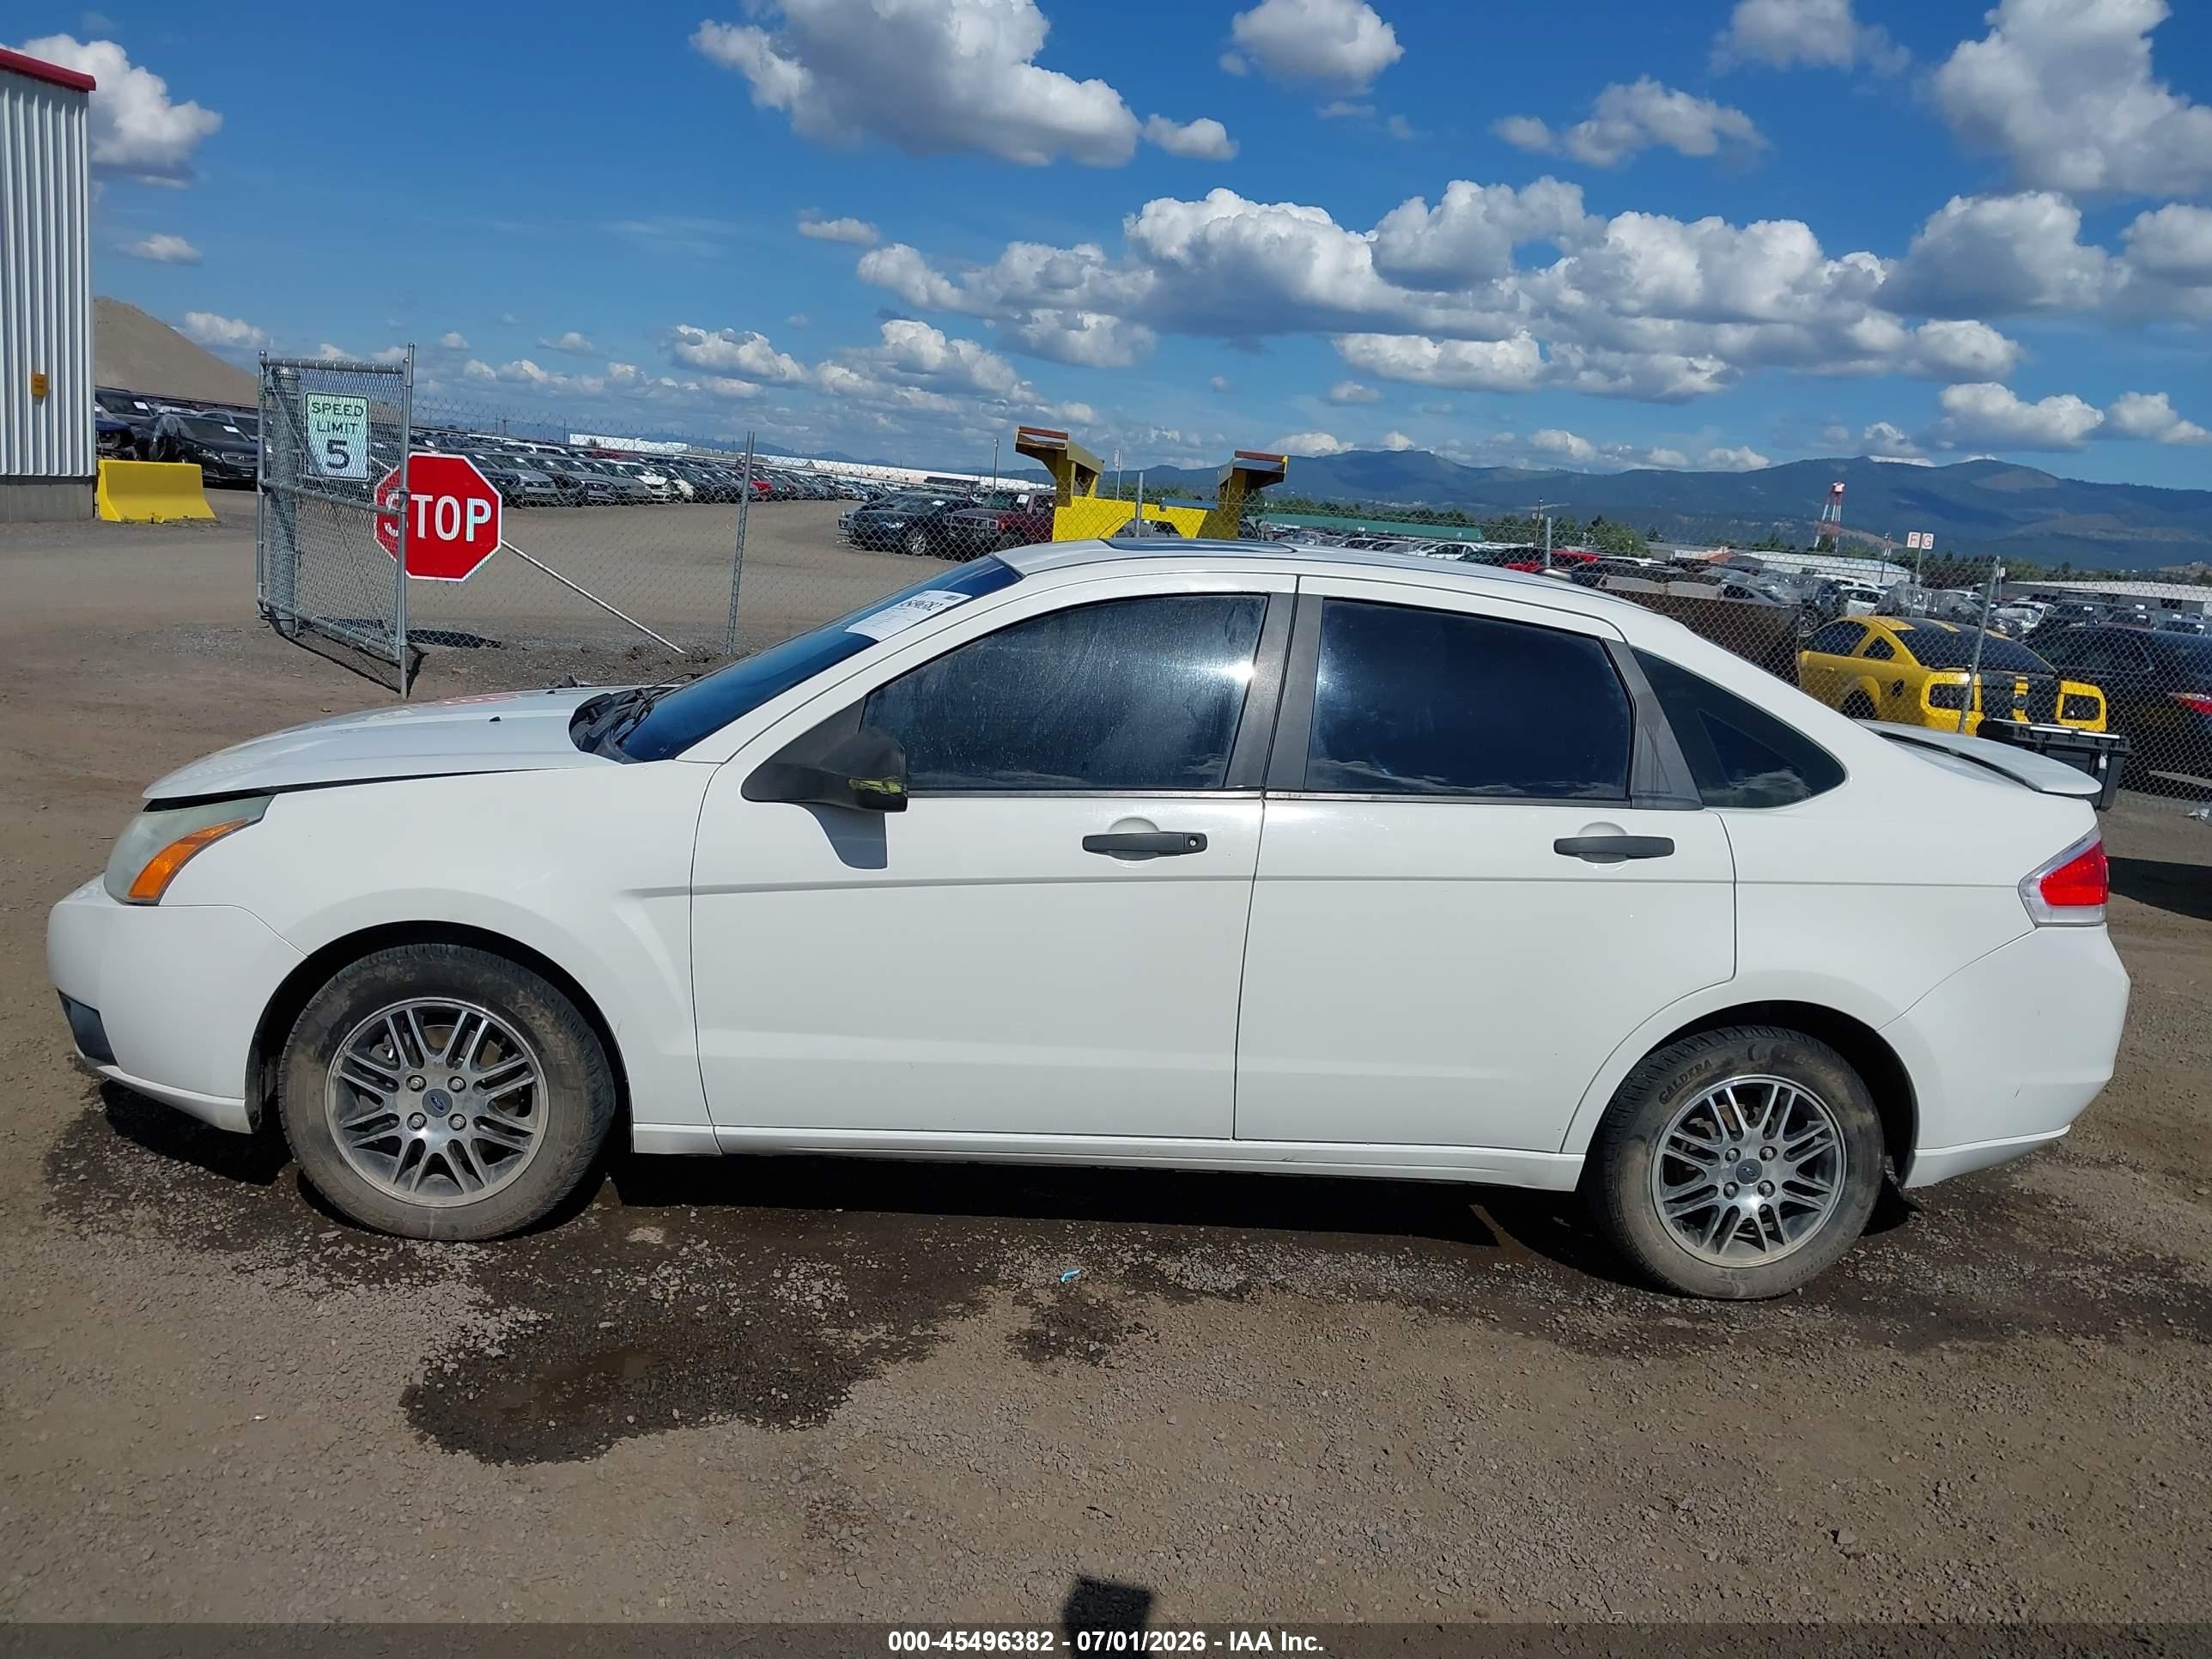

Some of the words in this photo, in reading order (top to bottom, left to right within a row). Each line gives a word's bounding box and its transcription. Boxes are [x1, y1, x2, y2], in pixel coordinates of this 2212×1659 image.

[312, 402, 364, 417] SPEED
[316, 422, 359, 434] LIMIT
[326, 439, 350, 470] 5
[1909, 533, 1918, 546] F
[1923, 534, 1932, 548] G
[1658, 1058, 1712, 1105] CALDERA
